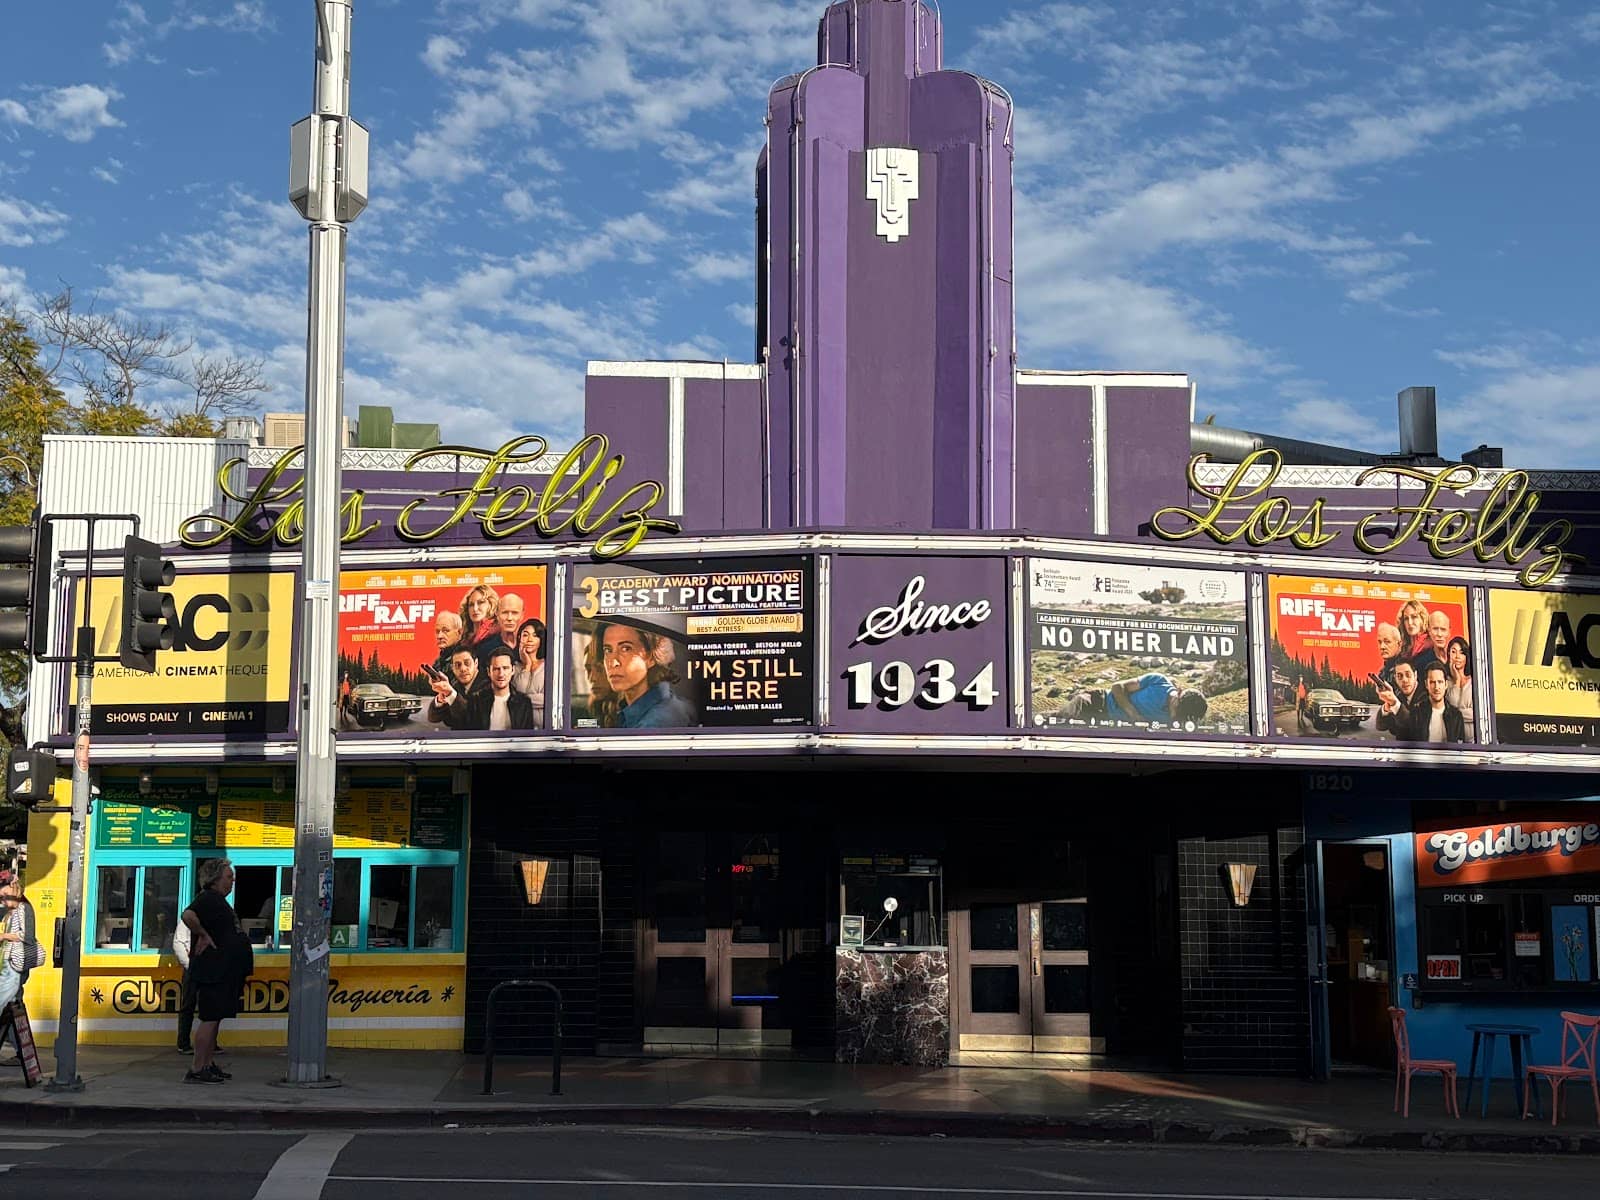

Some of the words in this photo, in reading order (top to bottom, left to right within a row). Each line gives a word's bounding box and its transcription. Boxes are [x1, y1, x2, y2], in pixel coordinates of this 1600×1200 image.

[395, 432, 683, 559] Feliz
[1150, 446, 1343, 549] Los
[1352, 463, 1588, 588] Feliz
[602, 577, 660, 590] ACADEMY
[663, 575, 708, 588] AWARD
[712, 572, 800, 586] NOMINATIONS
[578, 576, 599, 619] 3
[600, 588, 669, 607] BEST
[679, 583, 800, 605] PICTURE
[374, 604, 436, 624] RAFF
[707, 602, 758, 610] INTERNATIONAL
[853, 576, 992, 642] Since
[1279, 597, 1326, 618] RIFF
[717, 616, 745, 626] GOLDEN
[746, 615, 768, 625] GLOBE
[769, 614, 795, 624] AWARD
[1039, 615, 1071, 624] ACADEMY
[1071, 617, 1095, 625] AWARD
[1095, 619, 1125, 627] NOMINEE
[1157, 623, 1205, 632] DOCUMENTARY
[1206, 625, 1236, 634] FEATURE
[1321, 612, 1376, 633] RAFF
[781, 640, 803, 648] MELLO
[1041, 625, 1073, 648] NO
[1082, 628, 1162, 653] OTHER
[1171, 633, 1235, 657] LAND
[1541, 611, 1600, 669] AC
[703, 649, 738, 657] FERNANDA
[166, 664, 269, 677] CINEMATHEQUE
[687, 659, 721, 680] I'M
[732, 658, 803, 678] STILL
[710, 680, 779, 700] HERE
[846, 658, 1000, 707] 1934
[1510, 677, 1564, 690] AMERICAN
[760, 702, 783, 710] SALLES
[105, 712, 147, 724] SHOWS
[149, 711, 180, 723] DAILY
[202, 710, 246, 722] CINEMA
[247, 710, 254, 721] 1
[1523, 722, 1558, 734] SHOWS
[1559, 724, 1585, 735] DAILY
[1307, 774, 1353, 791] 1820
[1443, 893, 1466, 904] PICK
[1469, 893, 1484, 904] UP
[332, 929, 346, 945] A
[1426, 959, 1460, 977] OPEN
[112, 979, 183, 1014] GUA
